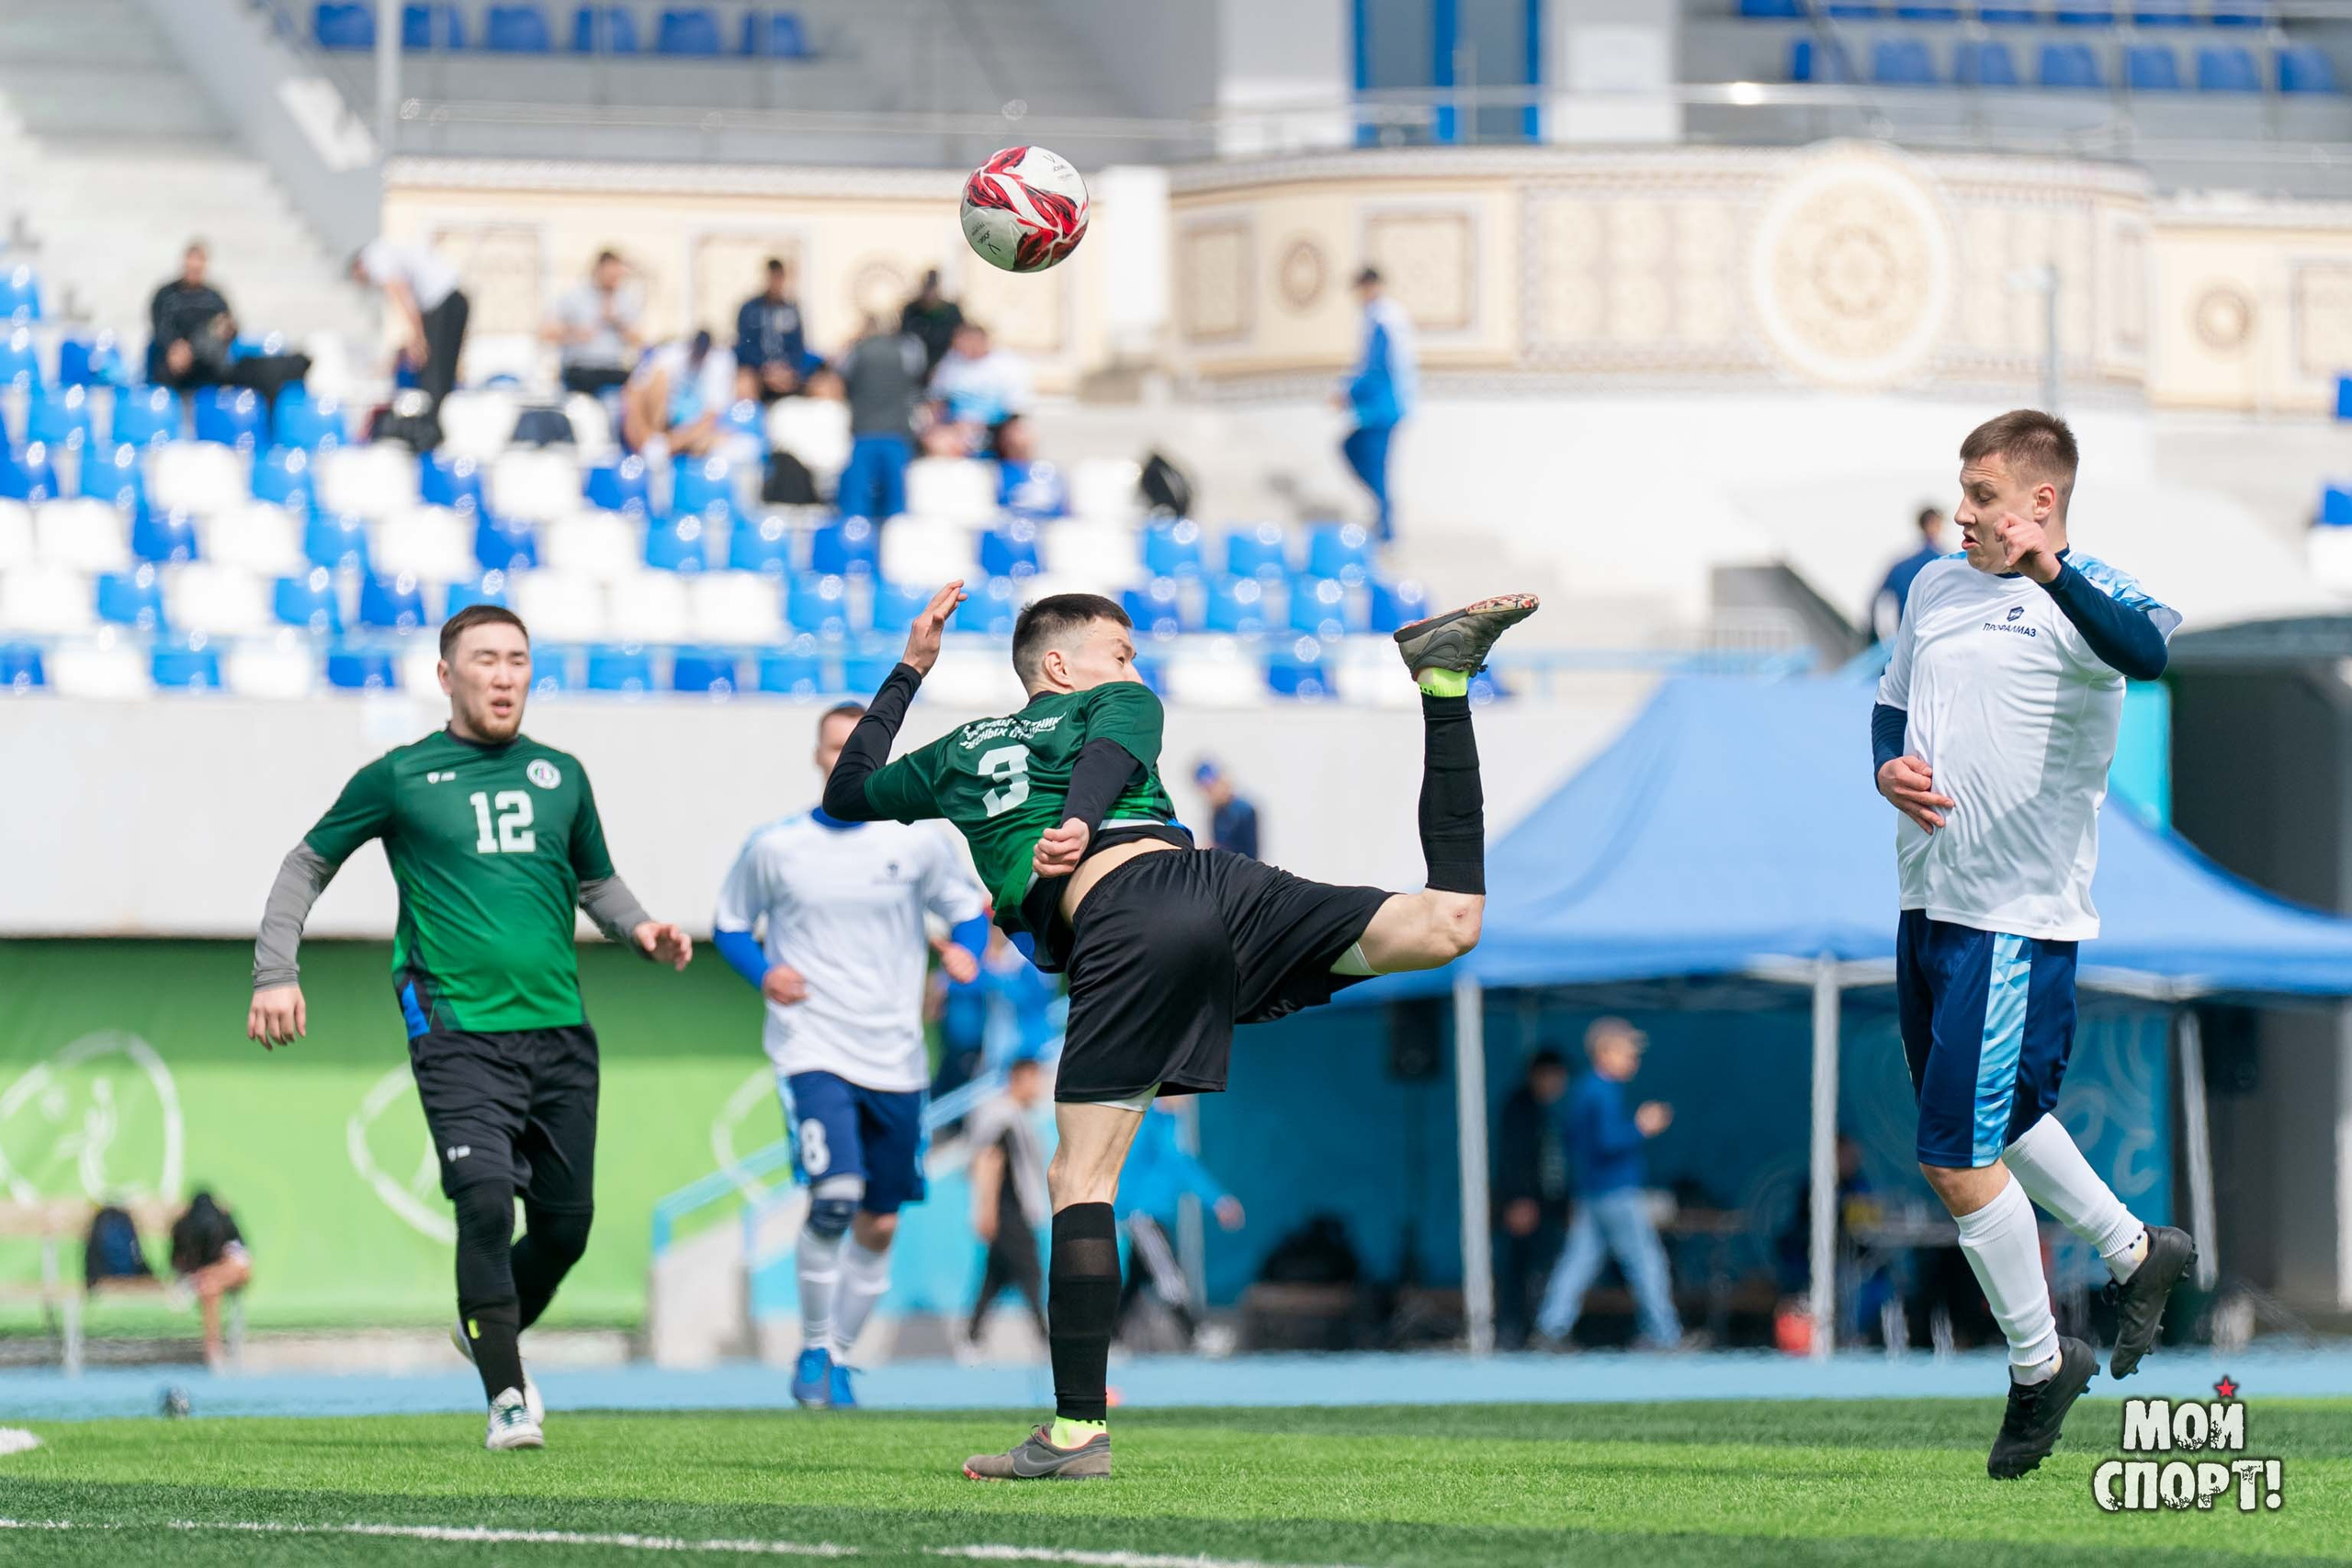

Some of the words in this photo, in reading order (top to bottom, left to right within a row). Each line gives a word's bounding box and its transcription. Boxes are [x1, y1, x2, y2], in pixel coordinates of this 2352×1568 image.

[1983, 622, 2037, 637] ПРОФАЛМАЗ
[978, 744, 1031, 818] 3
[469, 790, 536, 853] 12
[800, 1118, 831, 1176] 8
